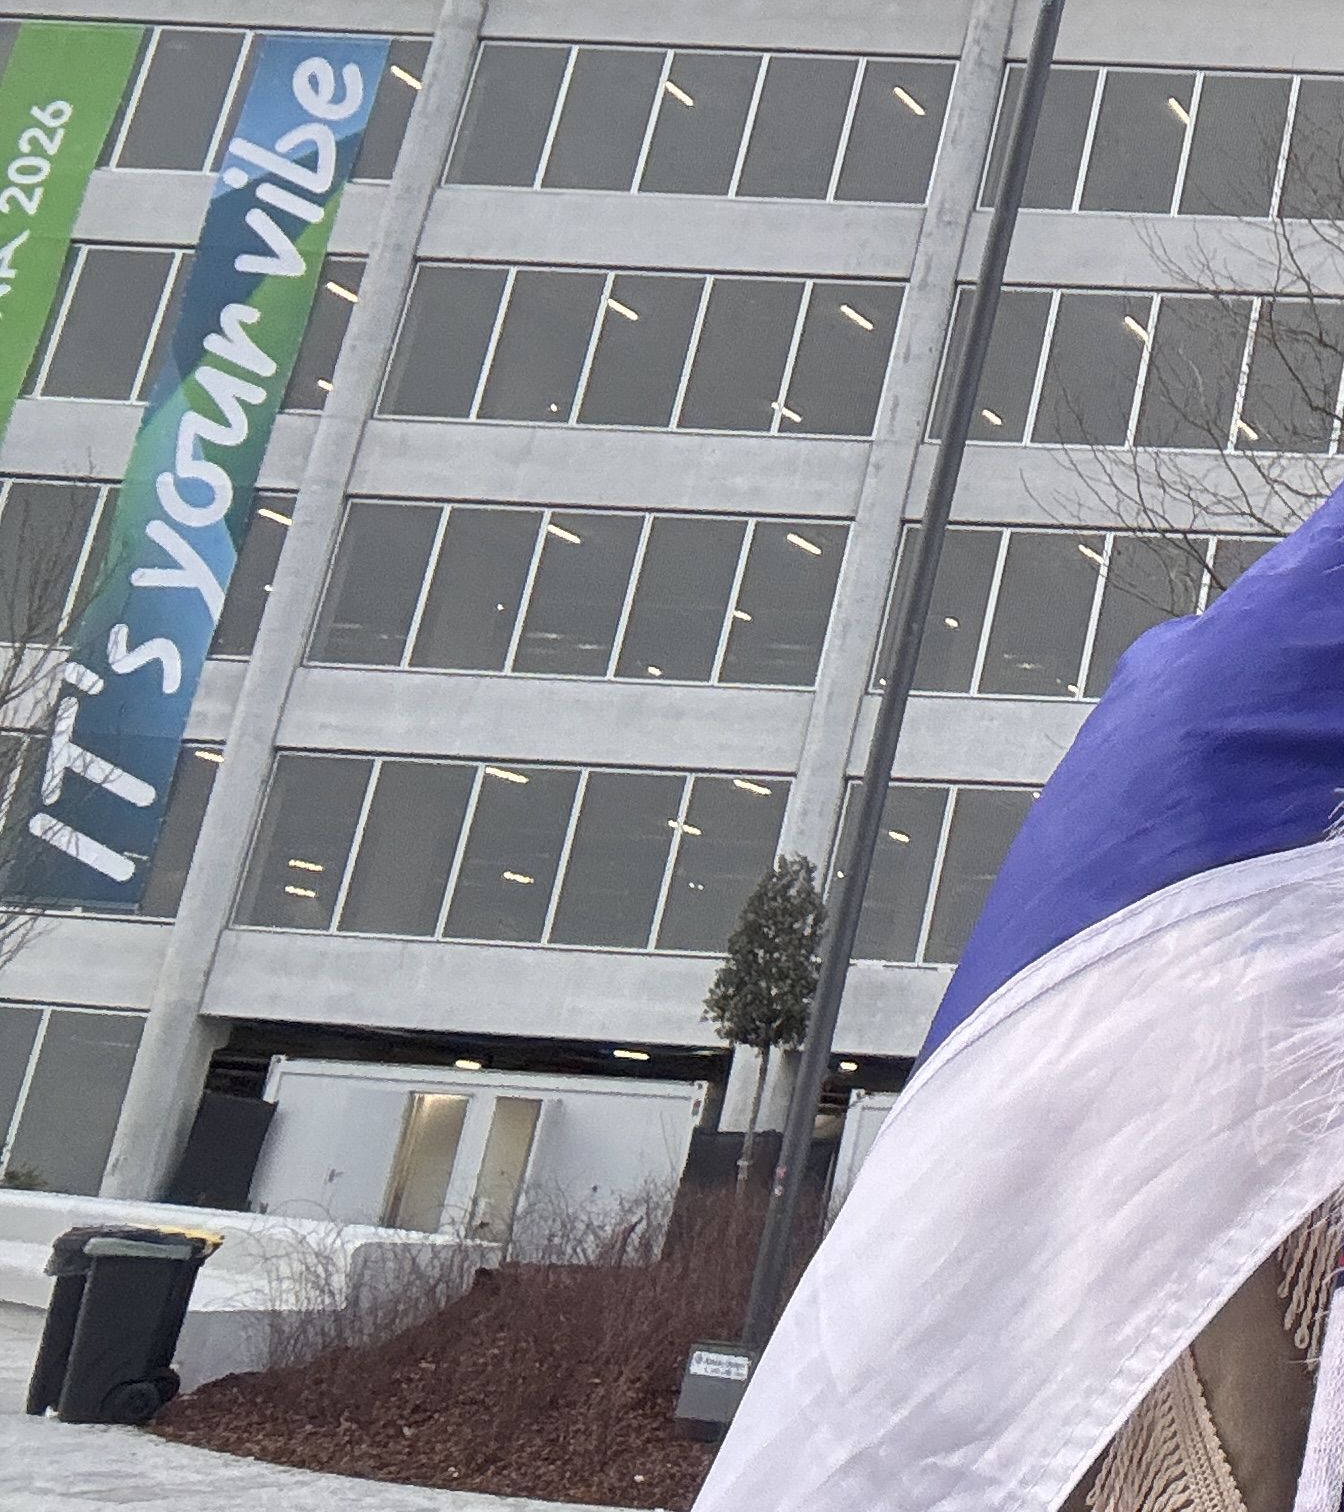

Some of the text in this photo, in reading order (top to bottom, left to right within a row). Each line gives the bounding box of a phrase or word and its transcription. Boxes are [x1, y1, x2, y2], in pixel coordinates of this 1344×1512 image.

[0, 99, 74, 215] 2026
[130, 302, 278, 625] your
[222, 53, 365, 279] vibe
